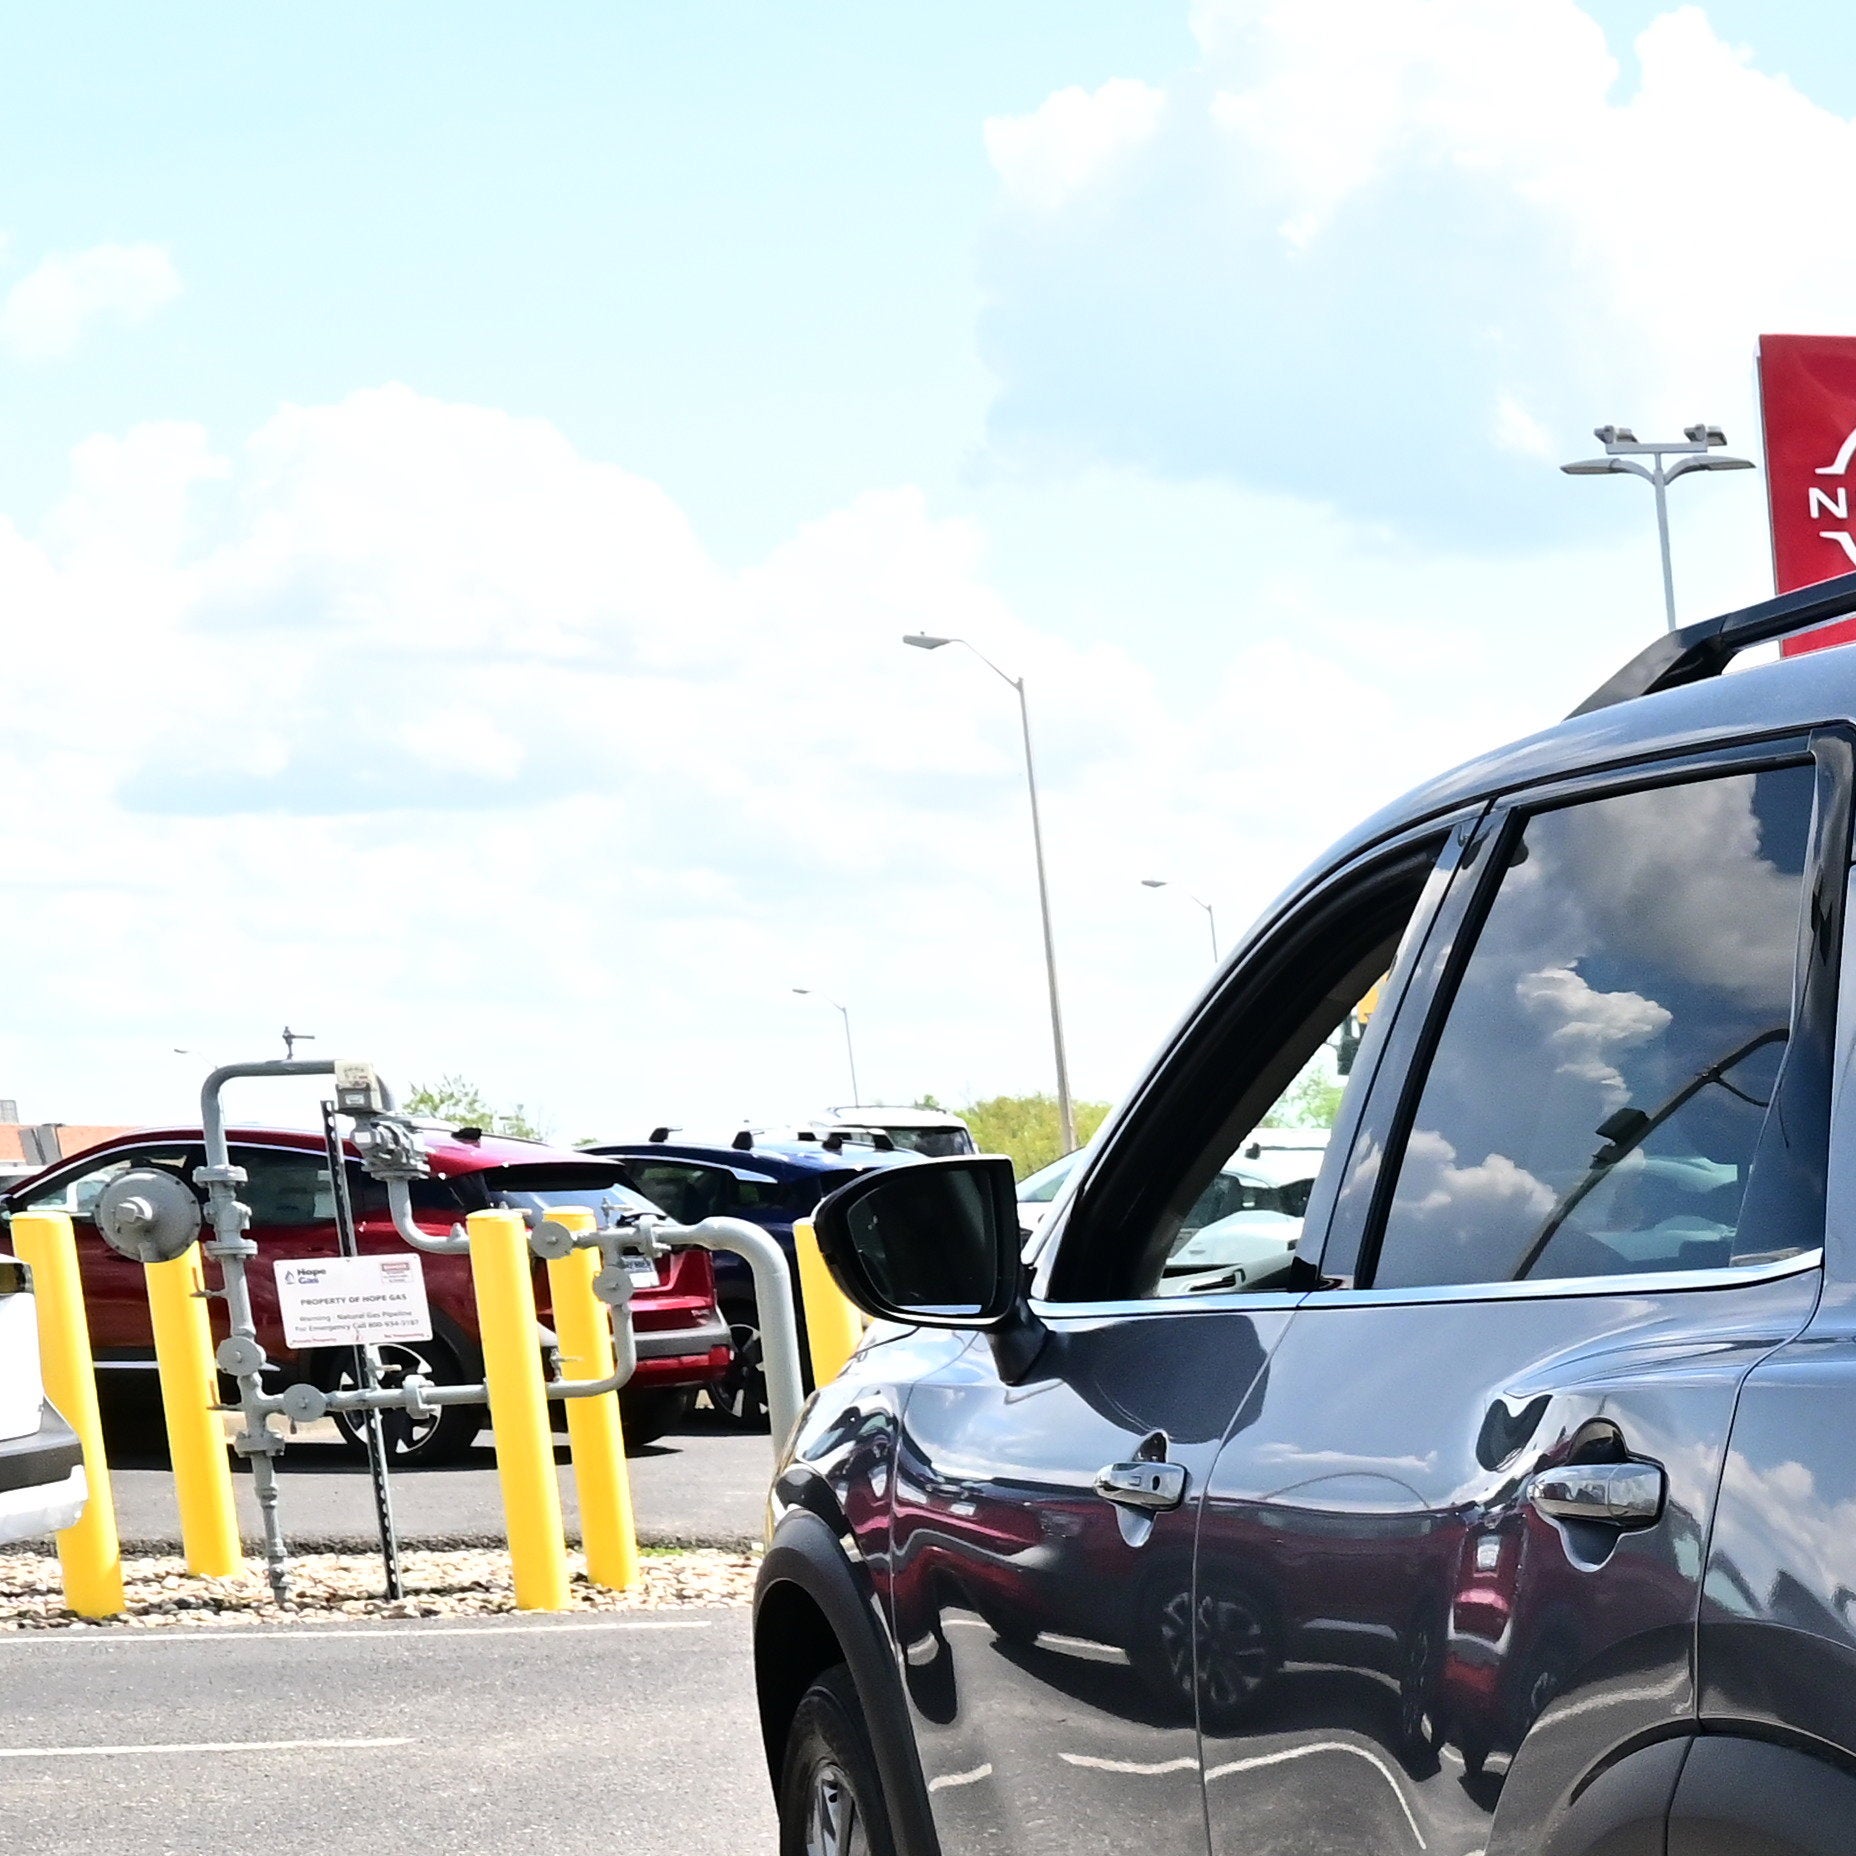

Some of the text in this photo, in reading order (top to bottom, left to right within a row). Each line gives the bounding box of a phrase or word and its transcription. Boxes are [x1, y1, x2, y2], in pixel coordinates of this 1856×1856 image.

[297, 1268, 326, 1277] Hope
[298, 1276, 319, 1284] Gas
[301, 1297, 346, 1305] PROPERTY
[389, 1293, 407, 1301] GAS
